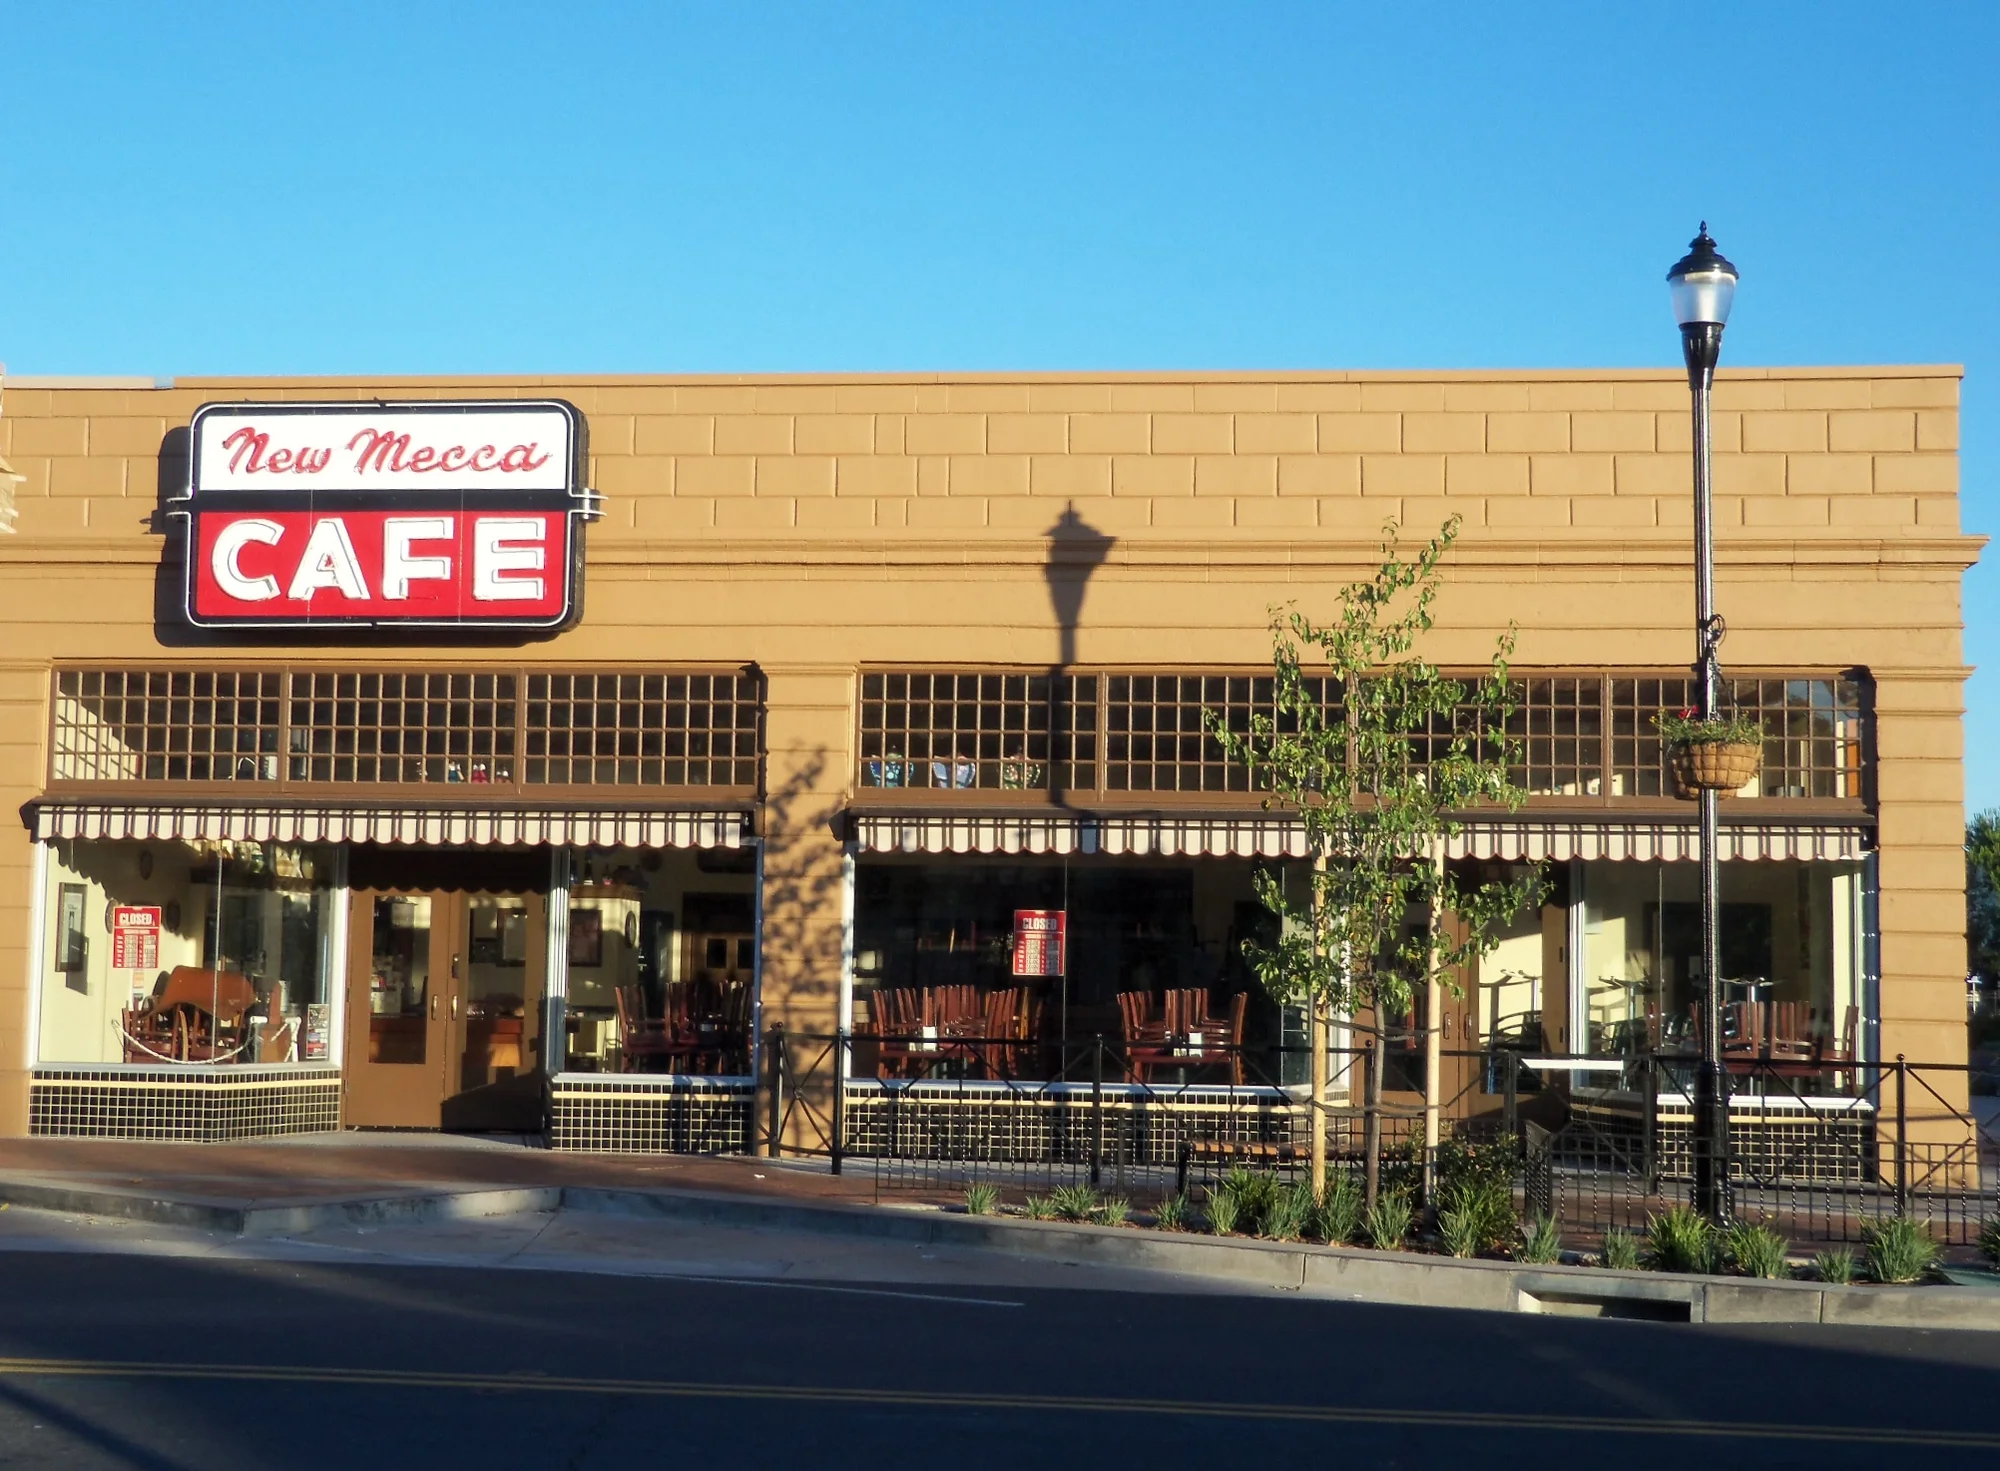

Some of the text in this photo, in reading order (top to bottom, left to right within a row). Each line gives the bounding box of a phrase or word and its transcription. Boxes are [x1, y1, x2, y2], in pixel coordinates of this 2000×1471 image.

[222, 426, 553, 476] New Mecca
[211, 516, 547, 602] CAFE
[119, 912, 153, 926] CLOSED
[1022, 917, 1057, 931] CLOSED
